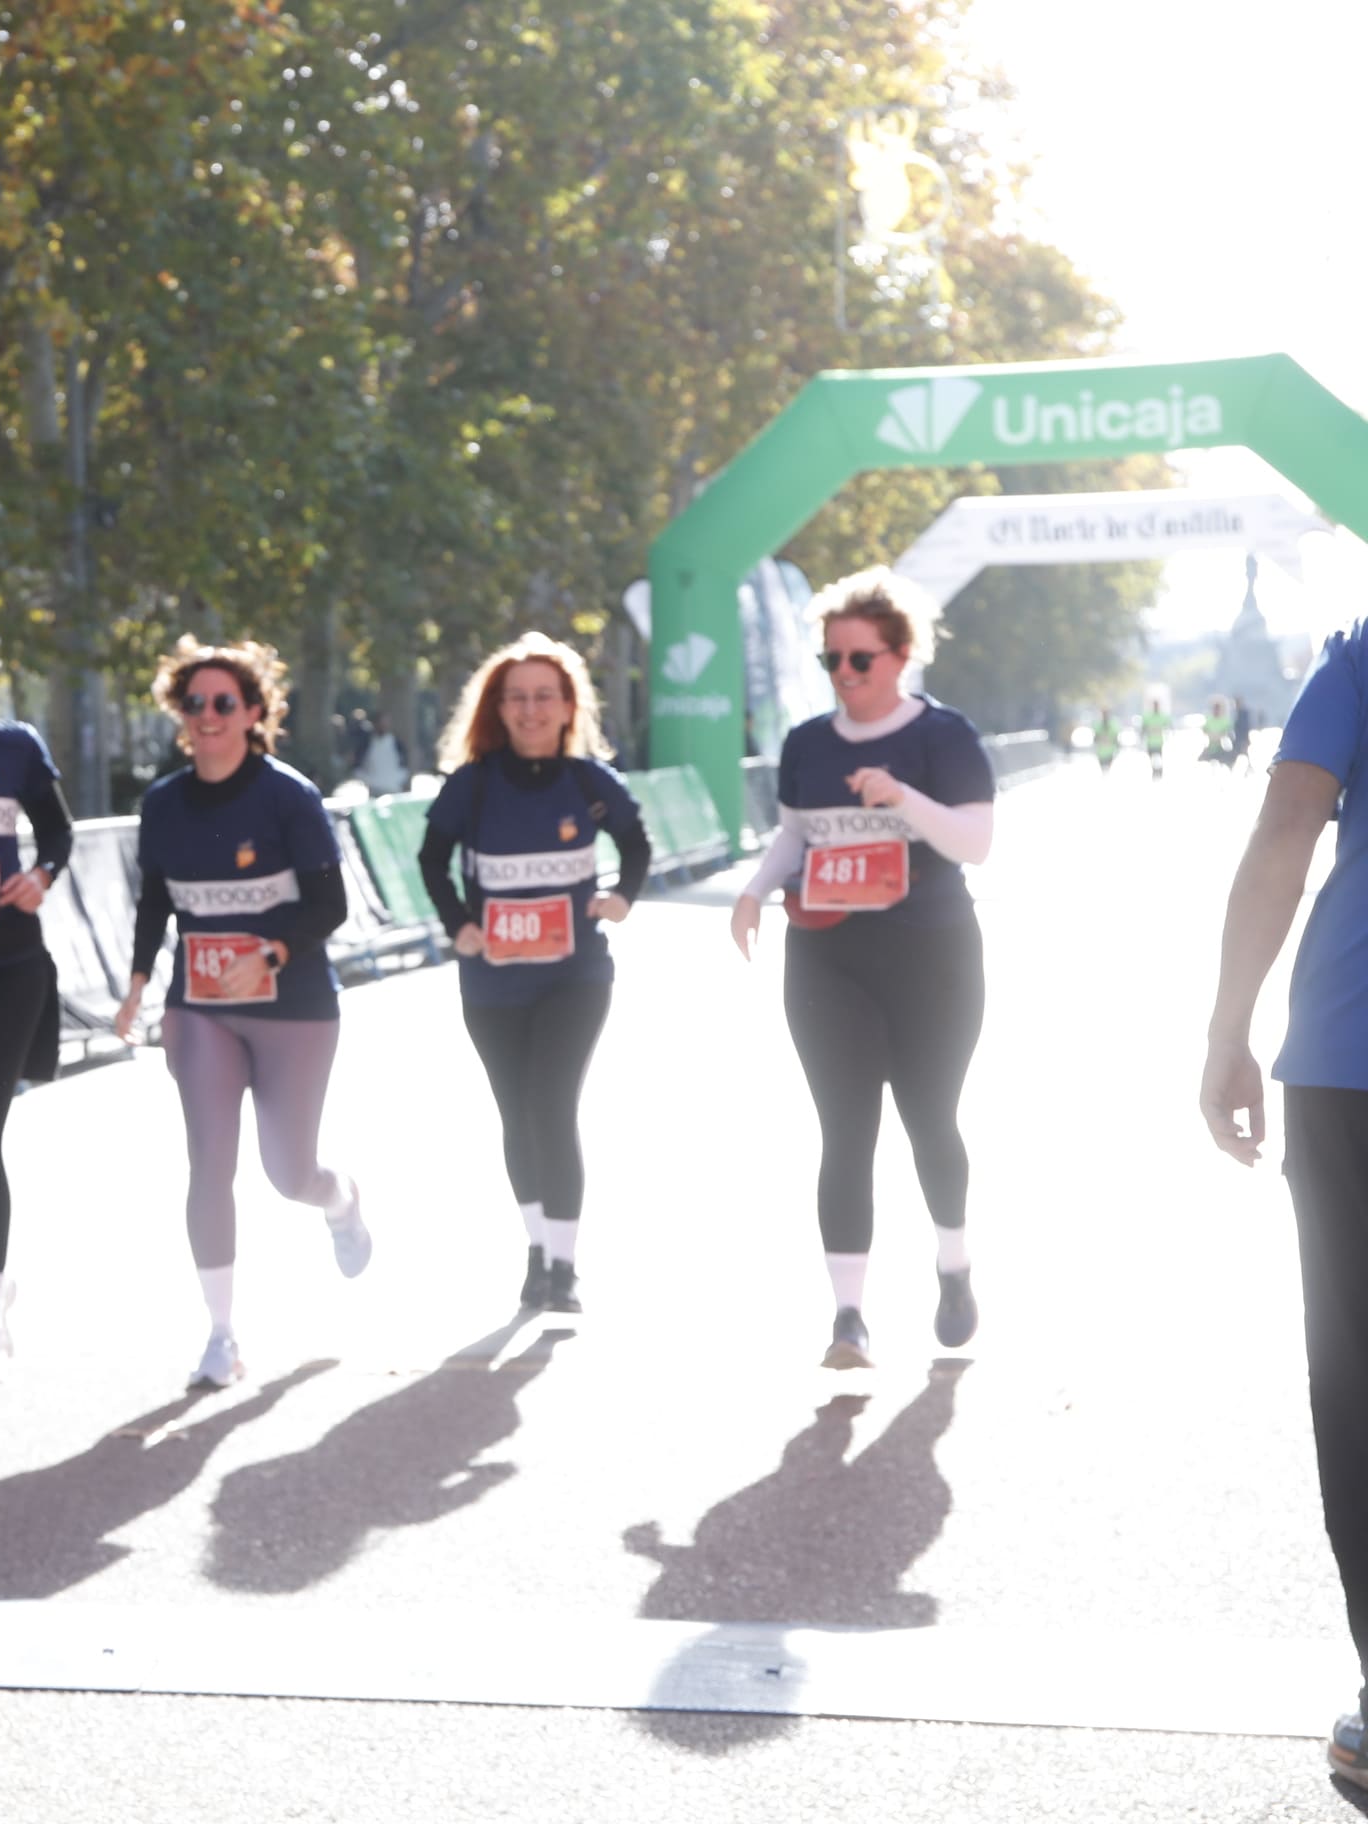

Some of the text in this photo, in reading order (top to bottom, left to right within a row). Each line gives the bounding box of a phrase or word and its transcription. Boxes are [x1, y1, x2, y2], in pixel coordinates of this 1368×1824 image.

[993, 385, 1222, 446] Unicaja
[817, 856, 866, 883] 481
[493, 912, 541, 942] 480
